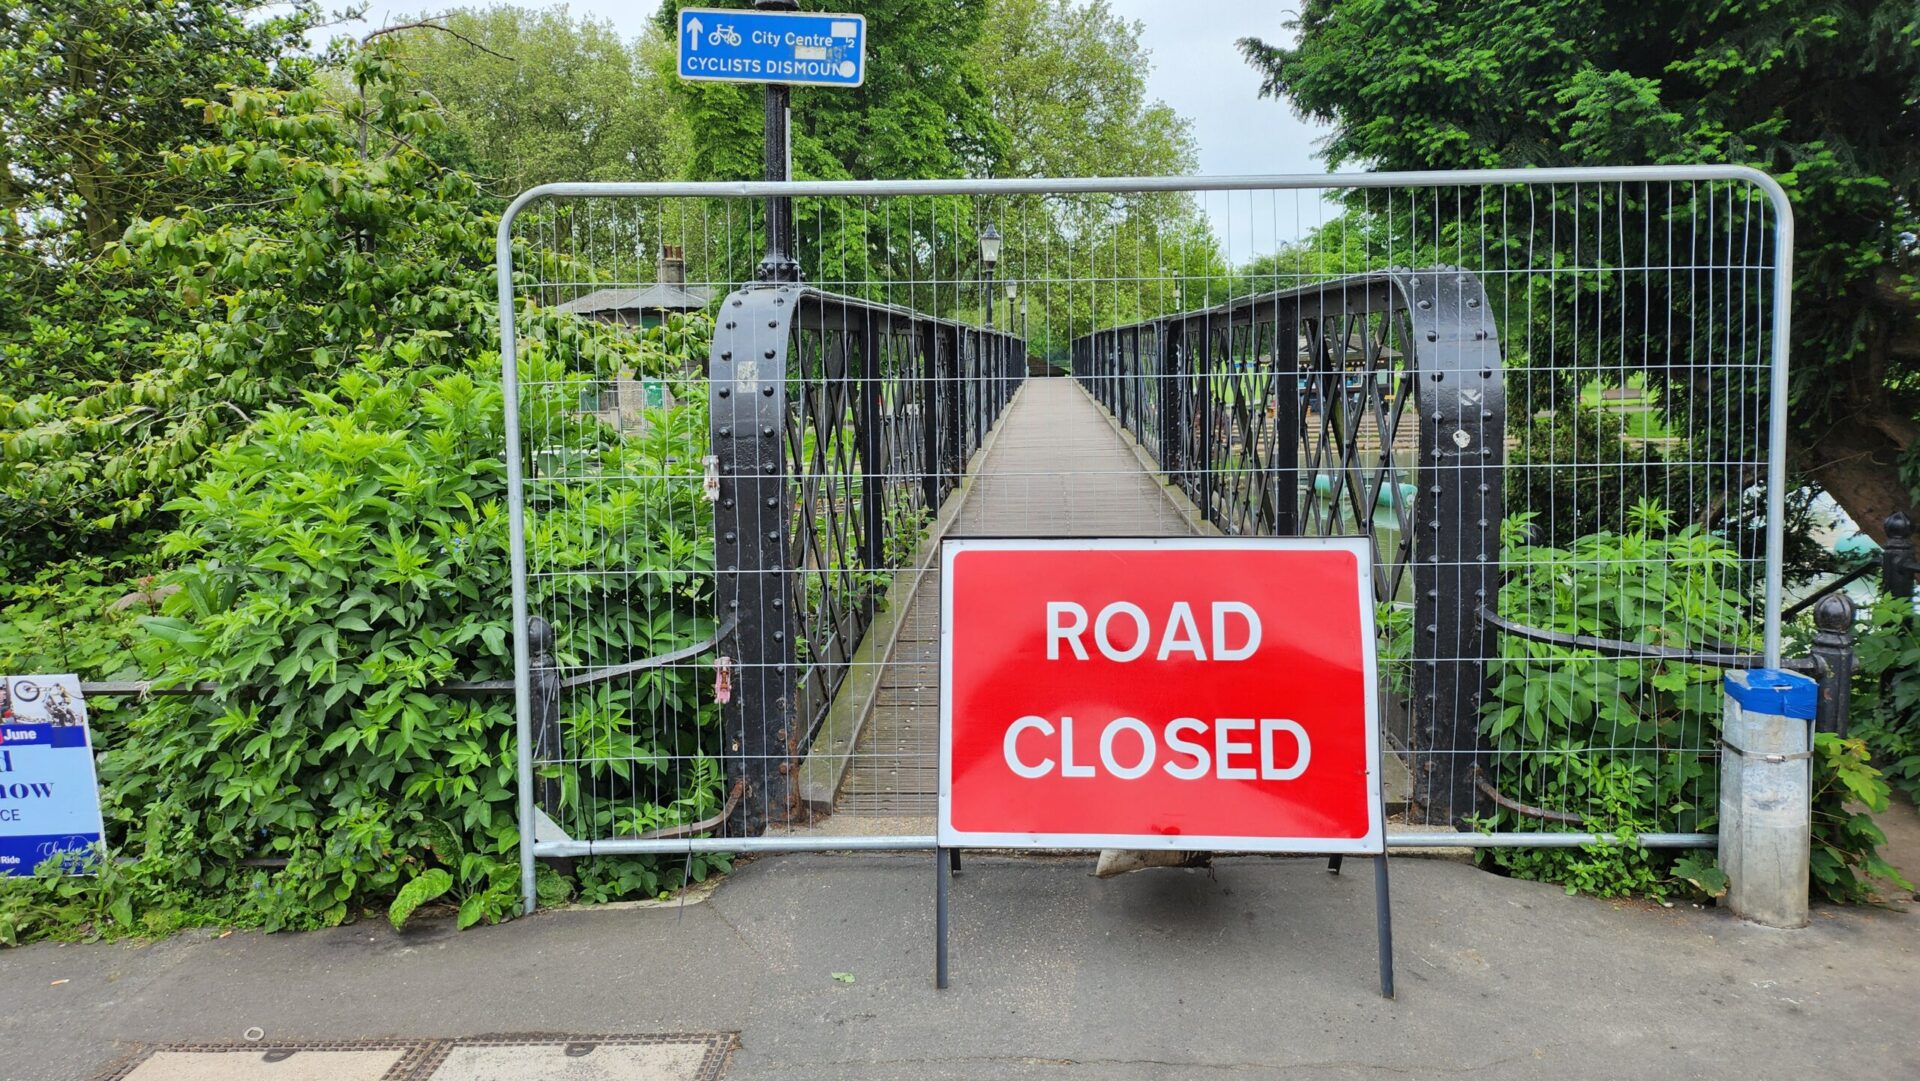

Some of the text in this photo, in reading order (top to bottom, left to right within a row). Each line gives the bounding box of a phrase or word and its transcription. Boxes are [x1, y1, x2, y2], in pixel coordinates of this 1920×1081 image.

[752, 30, 781, 47] City
[785, 31, 833, 47] Centre
[687, 57, 843, 77] CYCLISTS DISMOUN
[1046, 600, 1262, 663] ROAD
[3, 728, 38, 741] June
[1003, 715, 1312, 781] CLOSED
